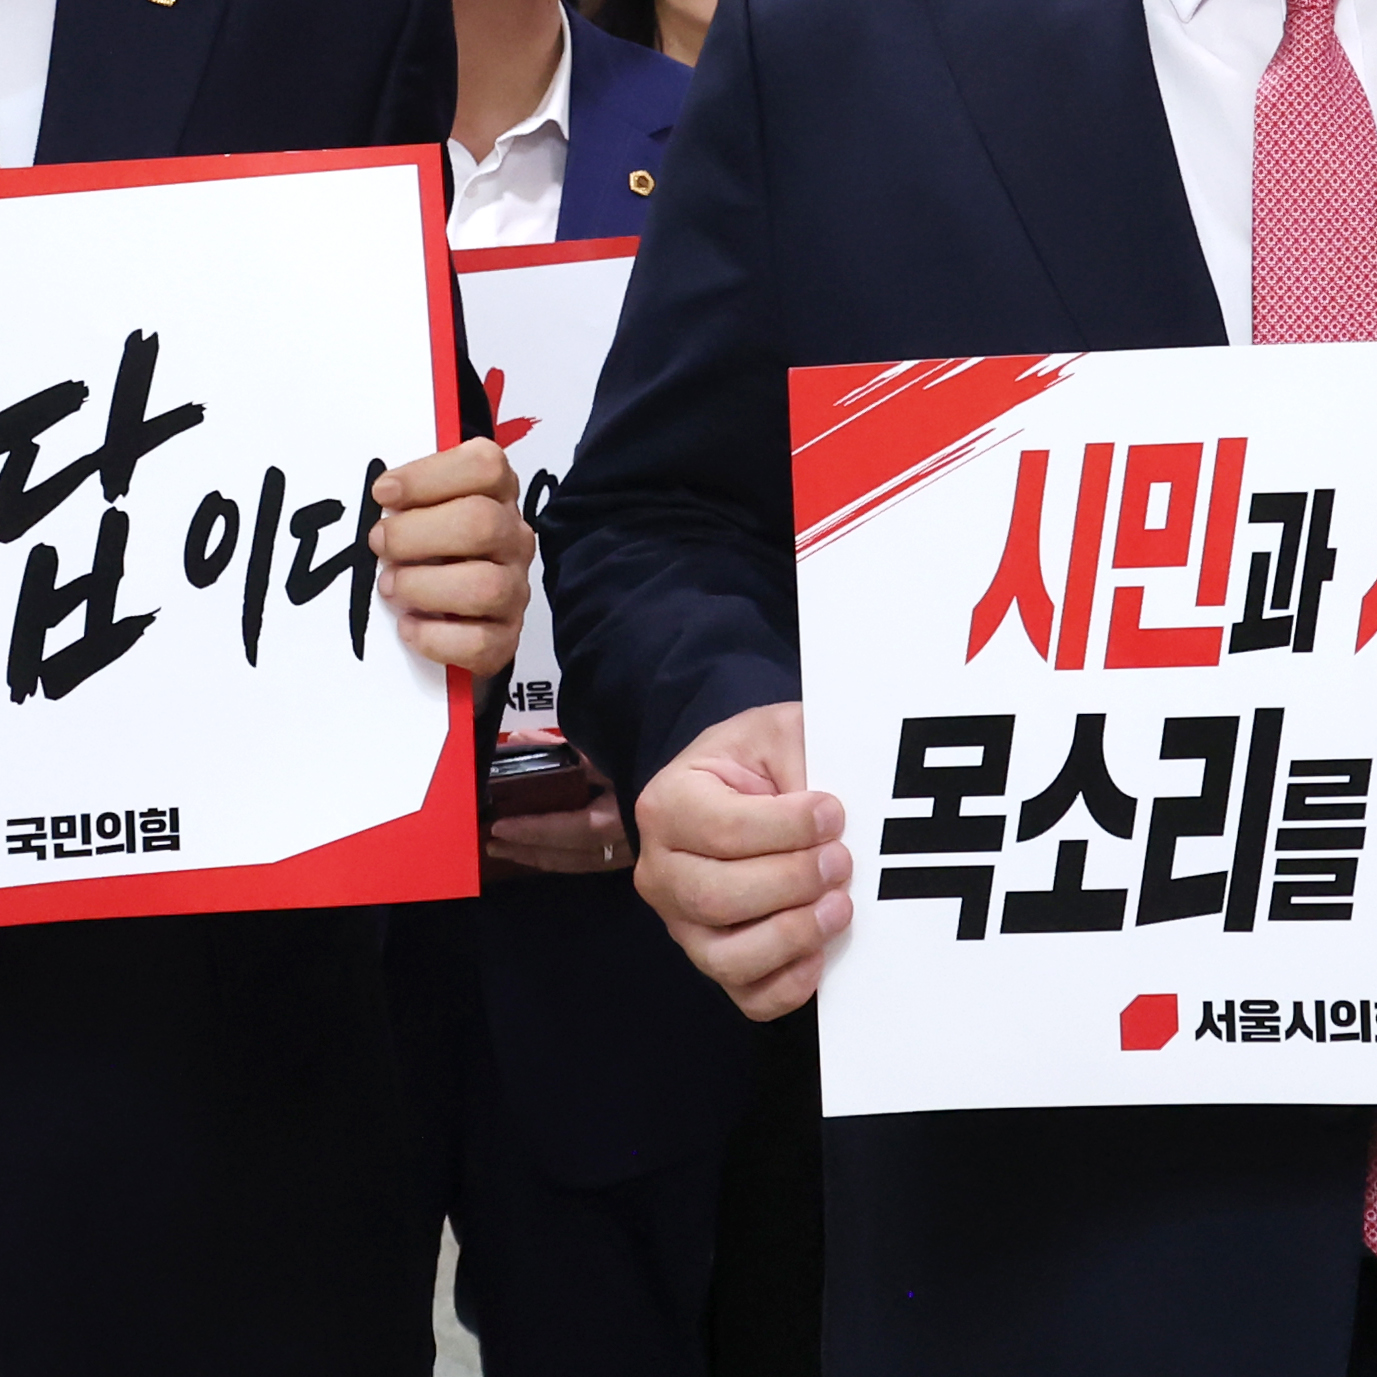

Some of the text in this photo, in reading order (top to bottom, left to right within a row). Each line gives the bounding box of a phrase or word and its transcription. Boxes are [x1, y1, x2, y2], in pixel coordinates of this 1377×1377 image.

[965, 437, 1338, 671] 시민과
[5, 807, 180, 861] 국민의힘
[877, 707, 1373, 941] 목소리를
